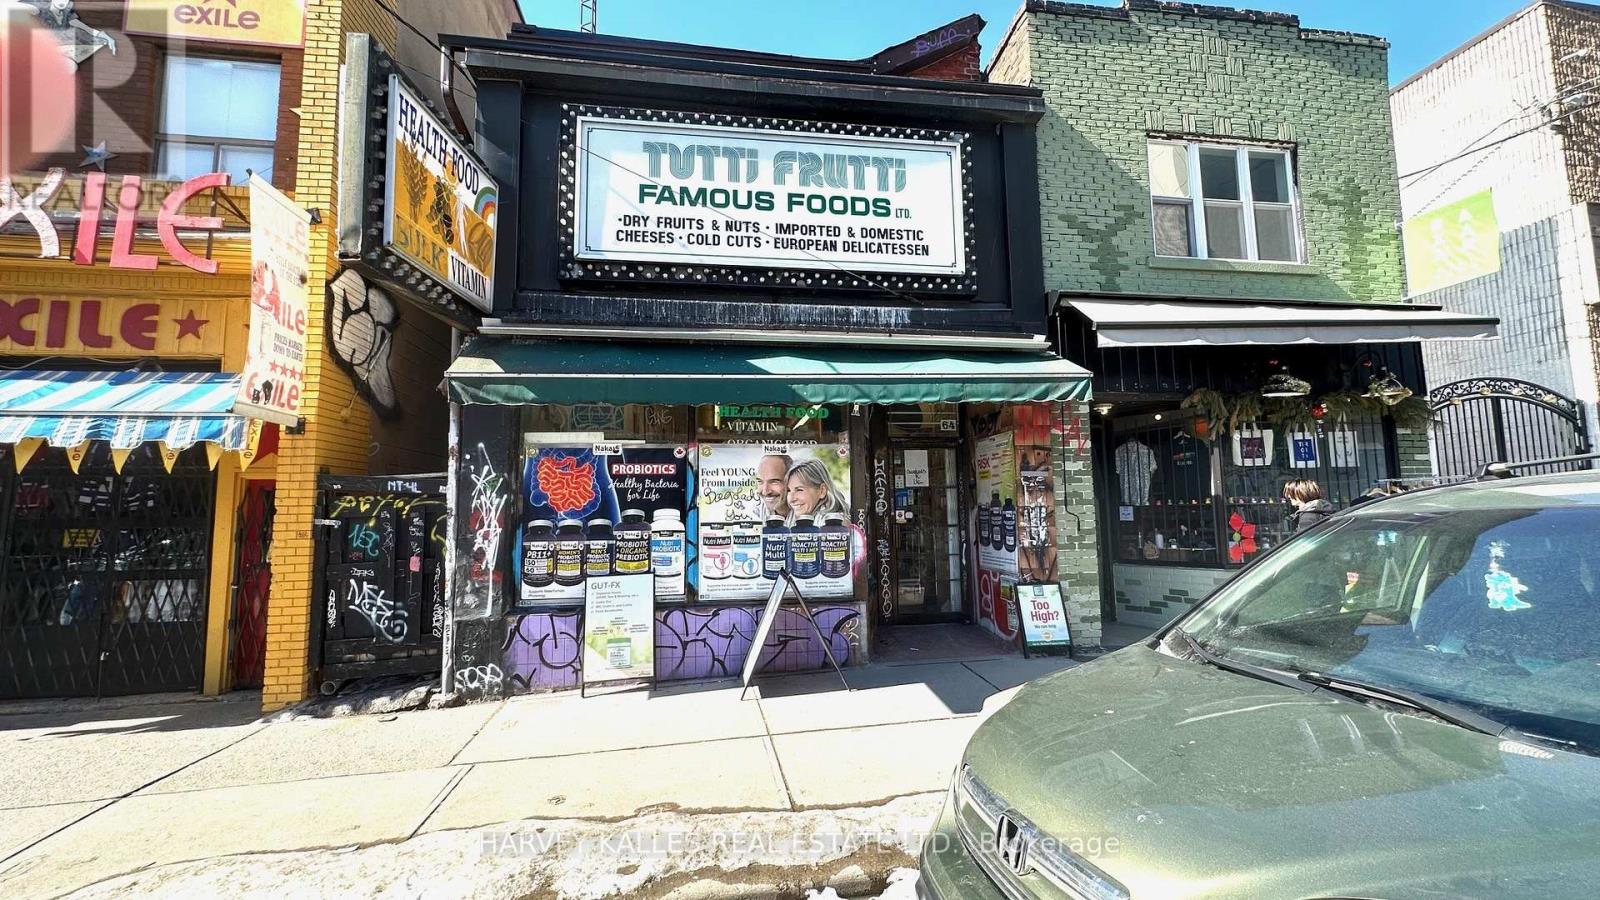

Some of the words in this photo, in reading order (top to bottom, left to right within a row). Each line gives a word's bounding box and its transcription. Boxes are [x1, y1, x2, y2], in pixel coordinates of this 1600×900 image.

[398, 92, 448, 168] HEALTH
[452, 147, 479, 195] FOOD
[638, 184, 775, 212] FAMOUS
[787, 192, 891, 218] FOODS
[895, 207, 912, 219] LTD.
[656, 216, 704, 231] FRUITS
[711, 219, 720, 231] &
[725, 220, 760, 234] NUTS
[774, 222, 841, 239] IMPORTED
[847, 226, 855, 239] &
[860, 226, 924, 242] DOMESTIC
[616, 229, 675, 245] CHEESES
[686, 232, 720, 247] COLD
[727, 234, 761, 249] CUTS
[774, 237, 838, 253] EUROPEAN
[843, 240, 929, 257] DELICATESSEN
[451, 255, 487, 300] VITAMIN
[719, 405, 781, 418] HEALTH
[786, 406, 829, 419] FOOD
[727, 421, 778, 432] VITAMIN
[942, 420, 955, 430] 64
[612, 464, 675, 475] PROBIOTICS
[701, 467, 719, 477] Feel
[721, 467, 755, 477] YOUNG
[608, 478, 643, 493] Healthy
[644, 478, 680, 489] Bacteria
[701, 478, 725, 487] From
[728, 478, 756, 487] Inside
[627, 489, 641, 502] for
[643, 488, 661, 501] Life
[616, 540, 648, 548] PROBIOTIC
[766, 542, 785, 551] Nutri
[615, 553, 648, 561] PREBIOTIC
[765, 551, 785, 559] Multi
[591, 581, 621, 590] GUT-FX
[1030, 600, 1049, 610] Too
[1030, 611, 1059, 623] High?
